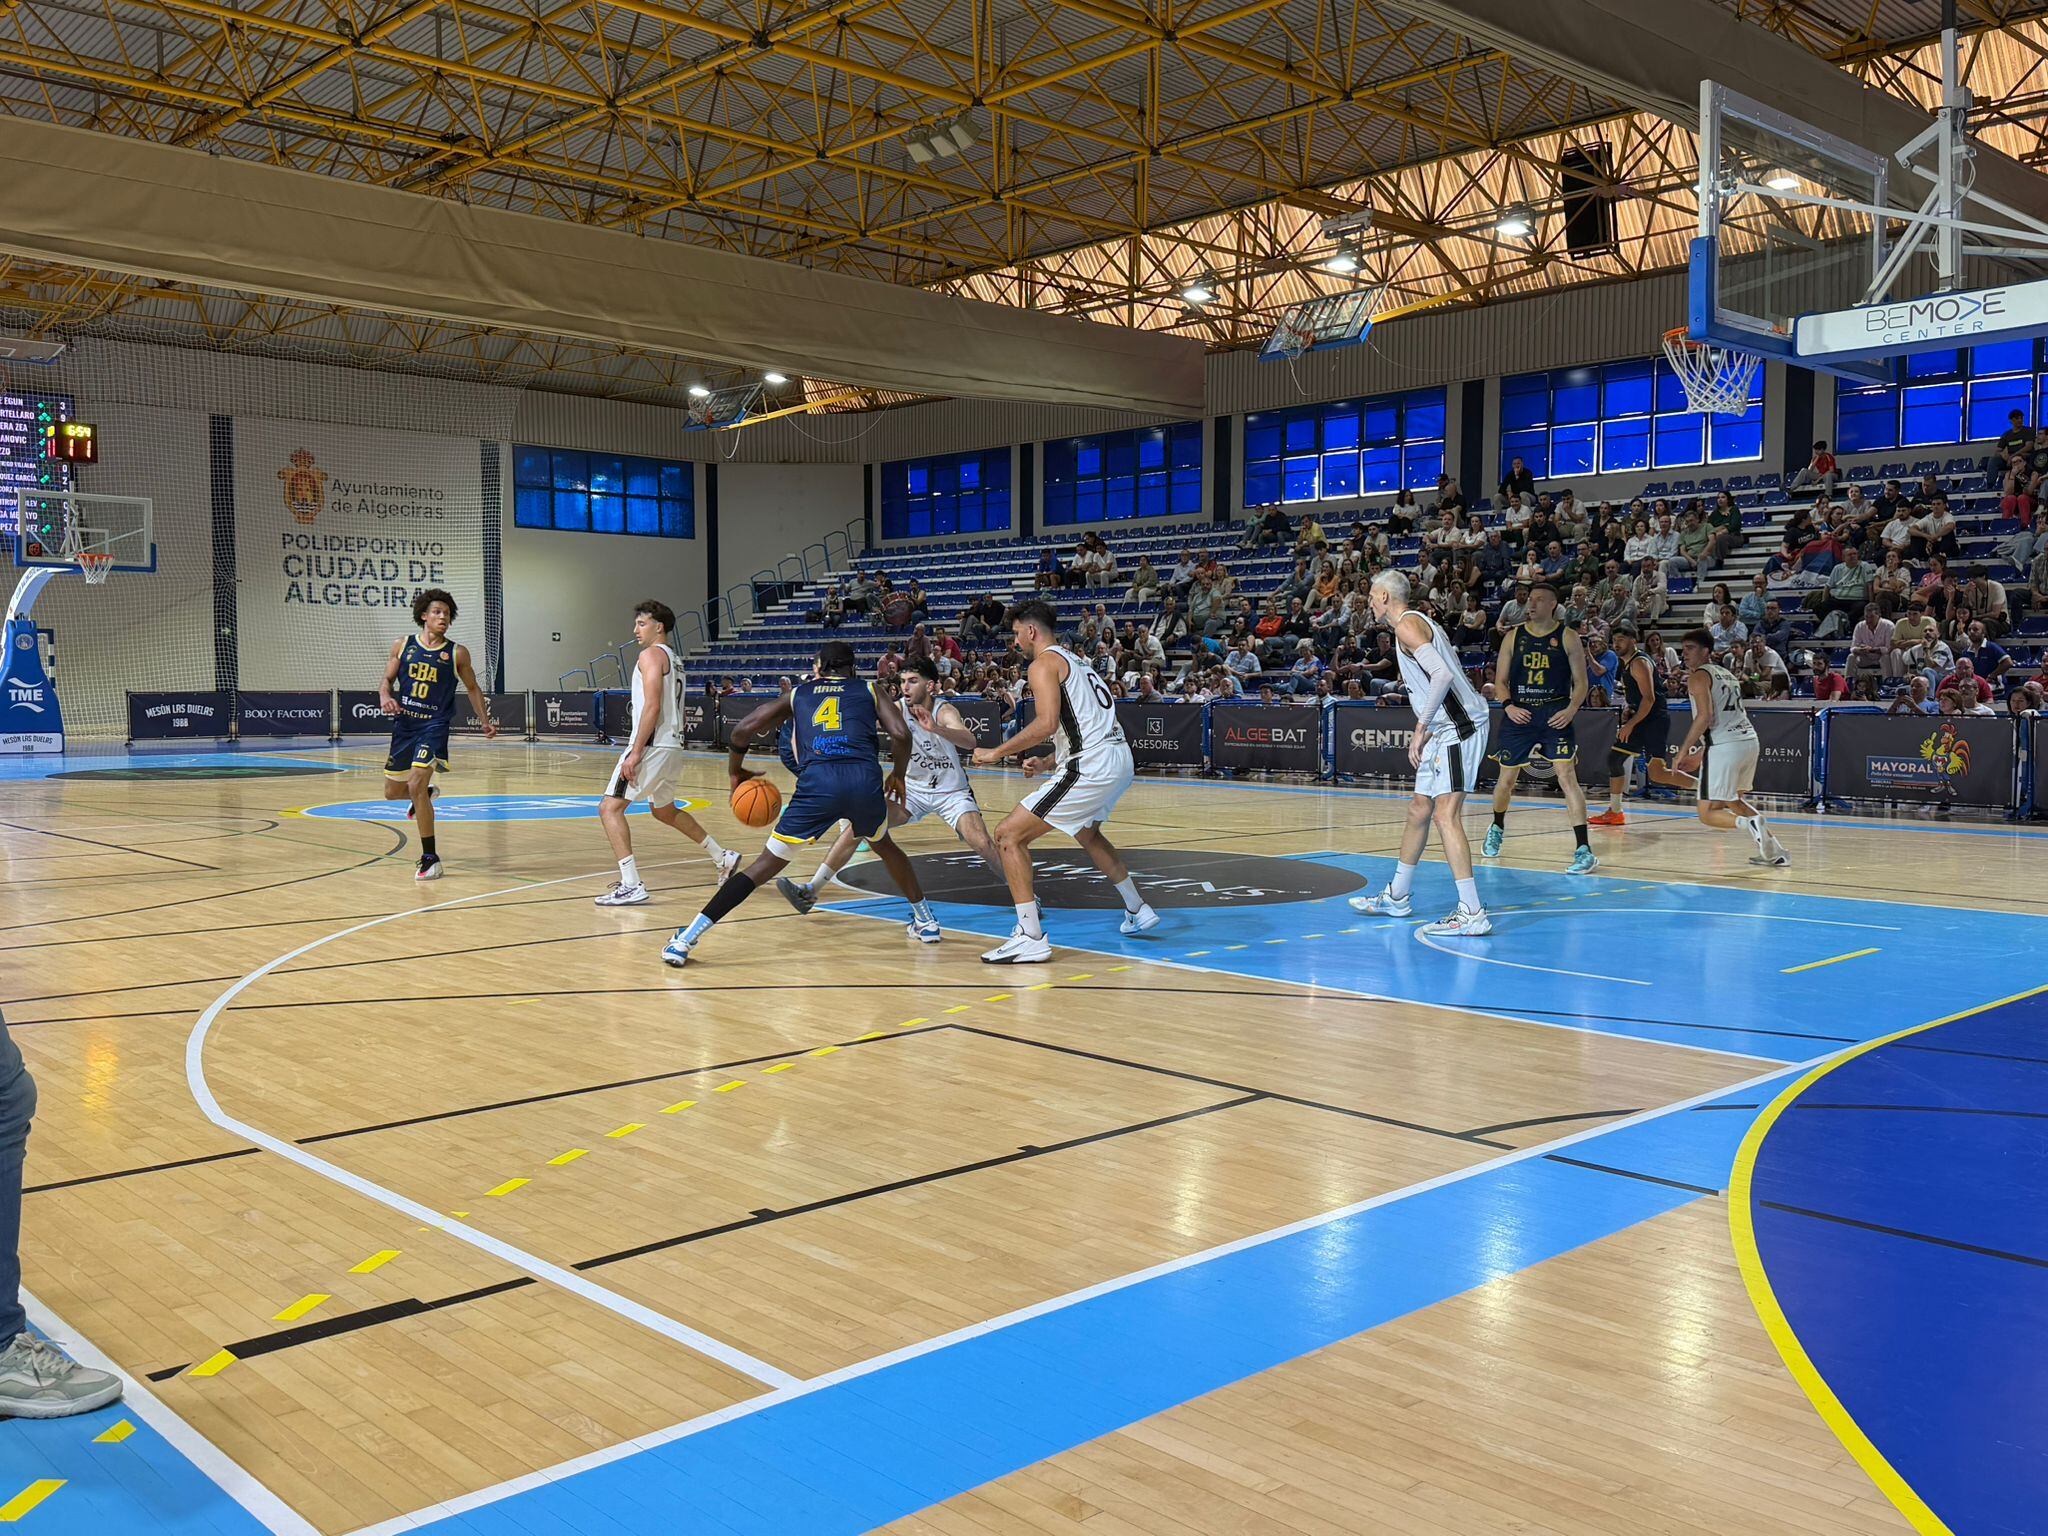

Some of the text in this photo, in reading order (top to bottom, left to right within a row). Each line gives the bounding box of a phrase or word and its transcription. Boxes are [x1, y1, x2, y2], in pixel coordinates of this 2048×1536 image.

[1882, 320, 1984, 344] CENTER
[331, 478, 444, 501] Ayuntamiento
[331, 498, 444, 519] de Algeciras
[282, 533, 444, 556] POLIDEPORTIVO
[282, 554, 445, 584] CIUDAD DE
[284, 581, 424, 608] ALGECIRA
[1523, 651, 1550, 669] CBA
[408, 661, 438, 682] CBA
[1526, 670, 1545, 685] 14
[8, 689, 44, 702] TME
[410, 681, 430, 699] 10
[812, 685, 846, 695] MARK
[1086, 672, 1114, 710] 6
[172, 704, 186, 714] LAS
[187, 704, 215, 717] DUELAS
[244, 709, 324, 719] BODY FACTORY
[811, 696, 843, 732] 4
[172, 718, 189, 727] 1988
[1132, 739, 1180, 750] ASESORES
[1350, 728, 1416, 747] CENTR
[1556, 745, 1569, 755] 14
[1764, 747, 1802, 757] BAENA
[920, 761, 956, 771] OCHOA
[1871, 761, 1934, 774] MAYORAL
[928, 774, 939, 789] 4
